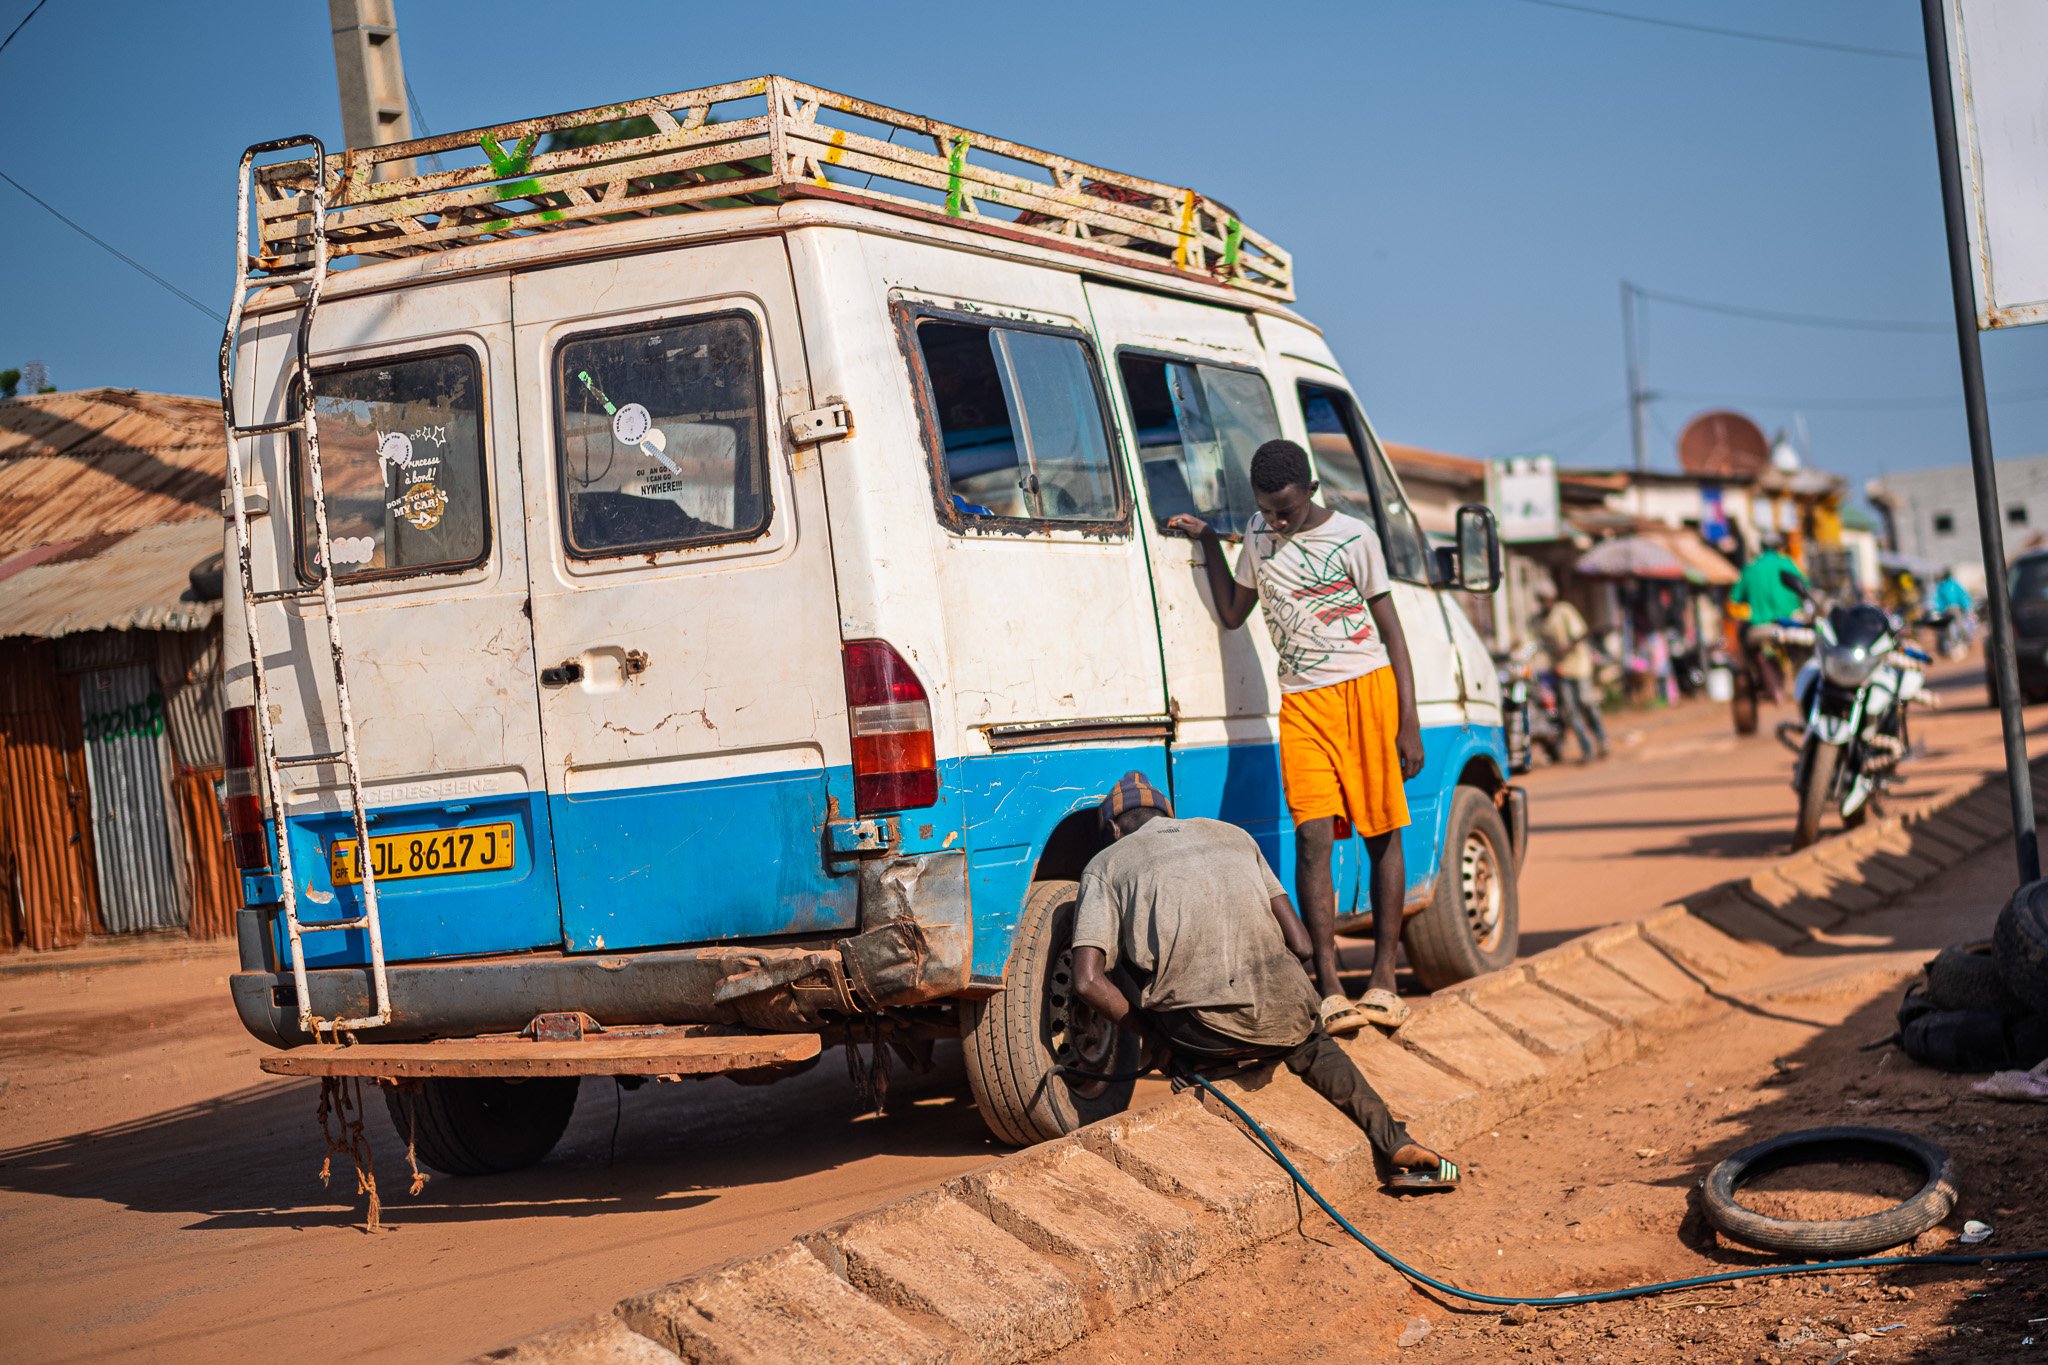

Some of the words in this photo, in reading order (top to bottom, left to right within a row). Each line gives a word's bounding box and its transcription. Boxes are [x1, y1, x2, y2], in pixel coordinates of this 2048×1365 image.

[405, 457, 441, 469] rincesse
[412, 467, 437, 484] bord!
[650, 475, 662, 483] CAN
[663, 473, 672, 481] GO
[410, 488, 435, 502] TOUCH
[393, 504, 411, 518] MY
[413, 497, 439, 511] CAR!
[1257, 567, 1307, 635] FASHION
[319, 776, 500, 810] MECEDES-BENZ
[409, 832, 475, 872] 8617
[480, 831, 497, 865] J
